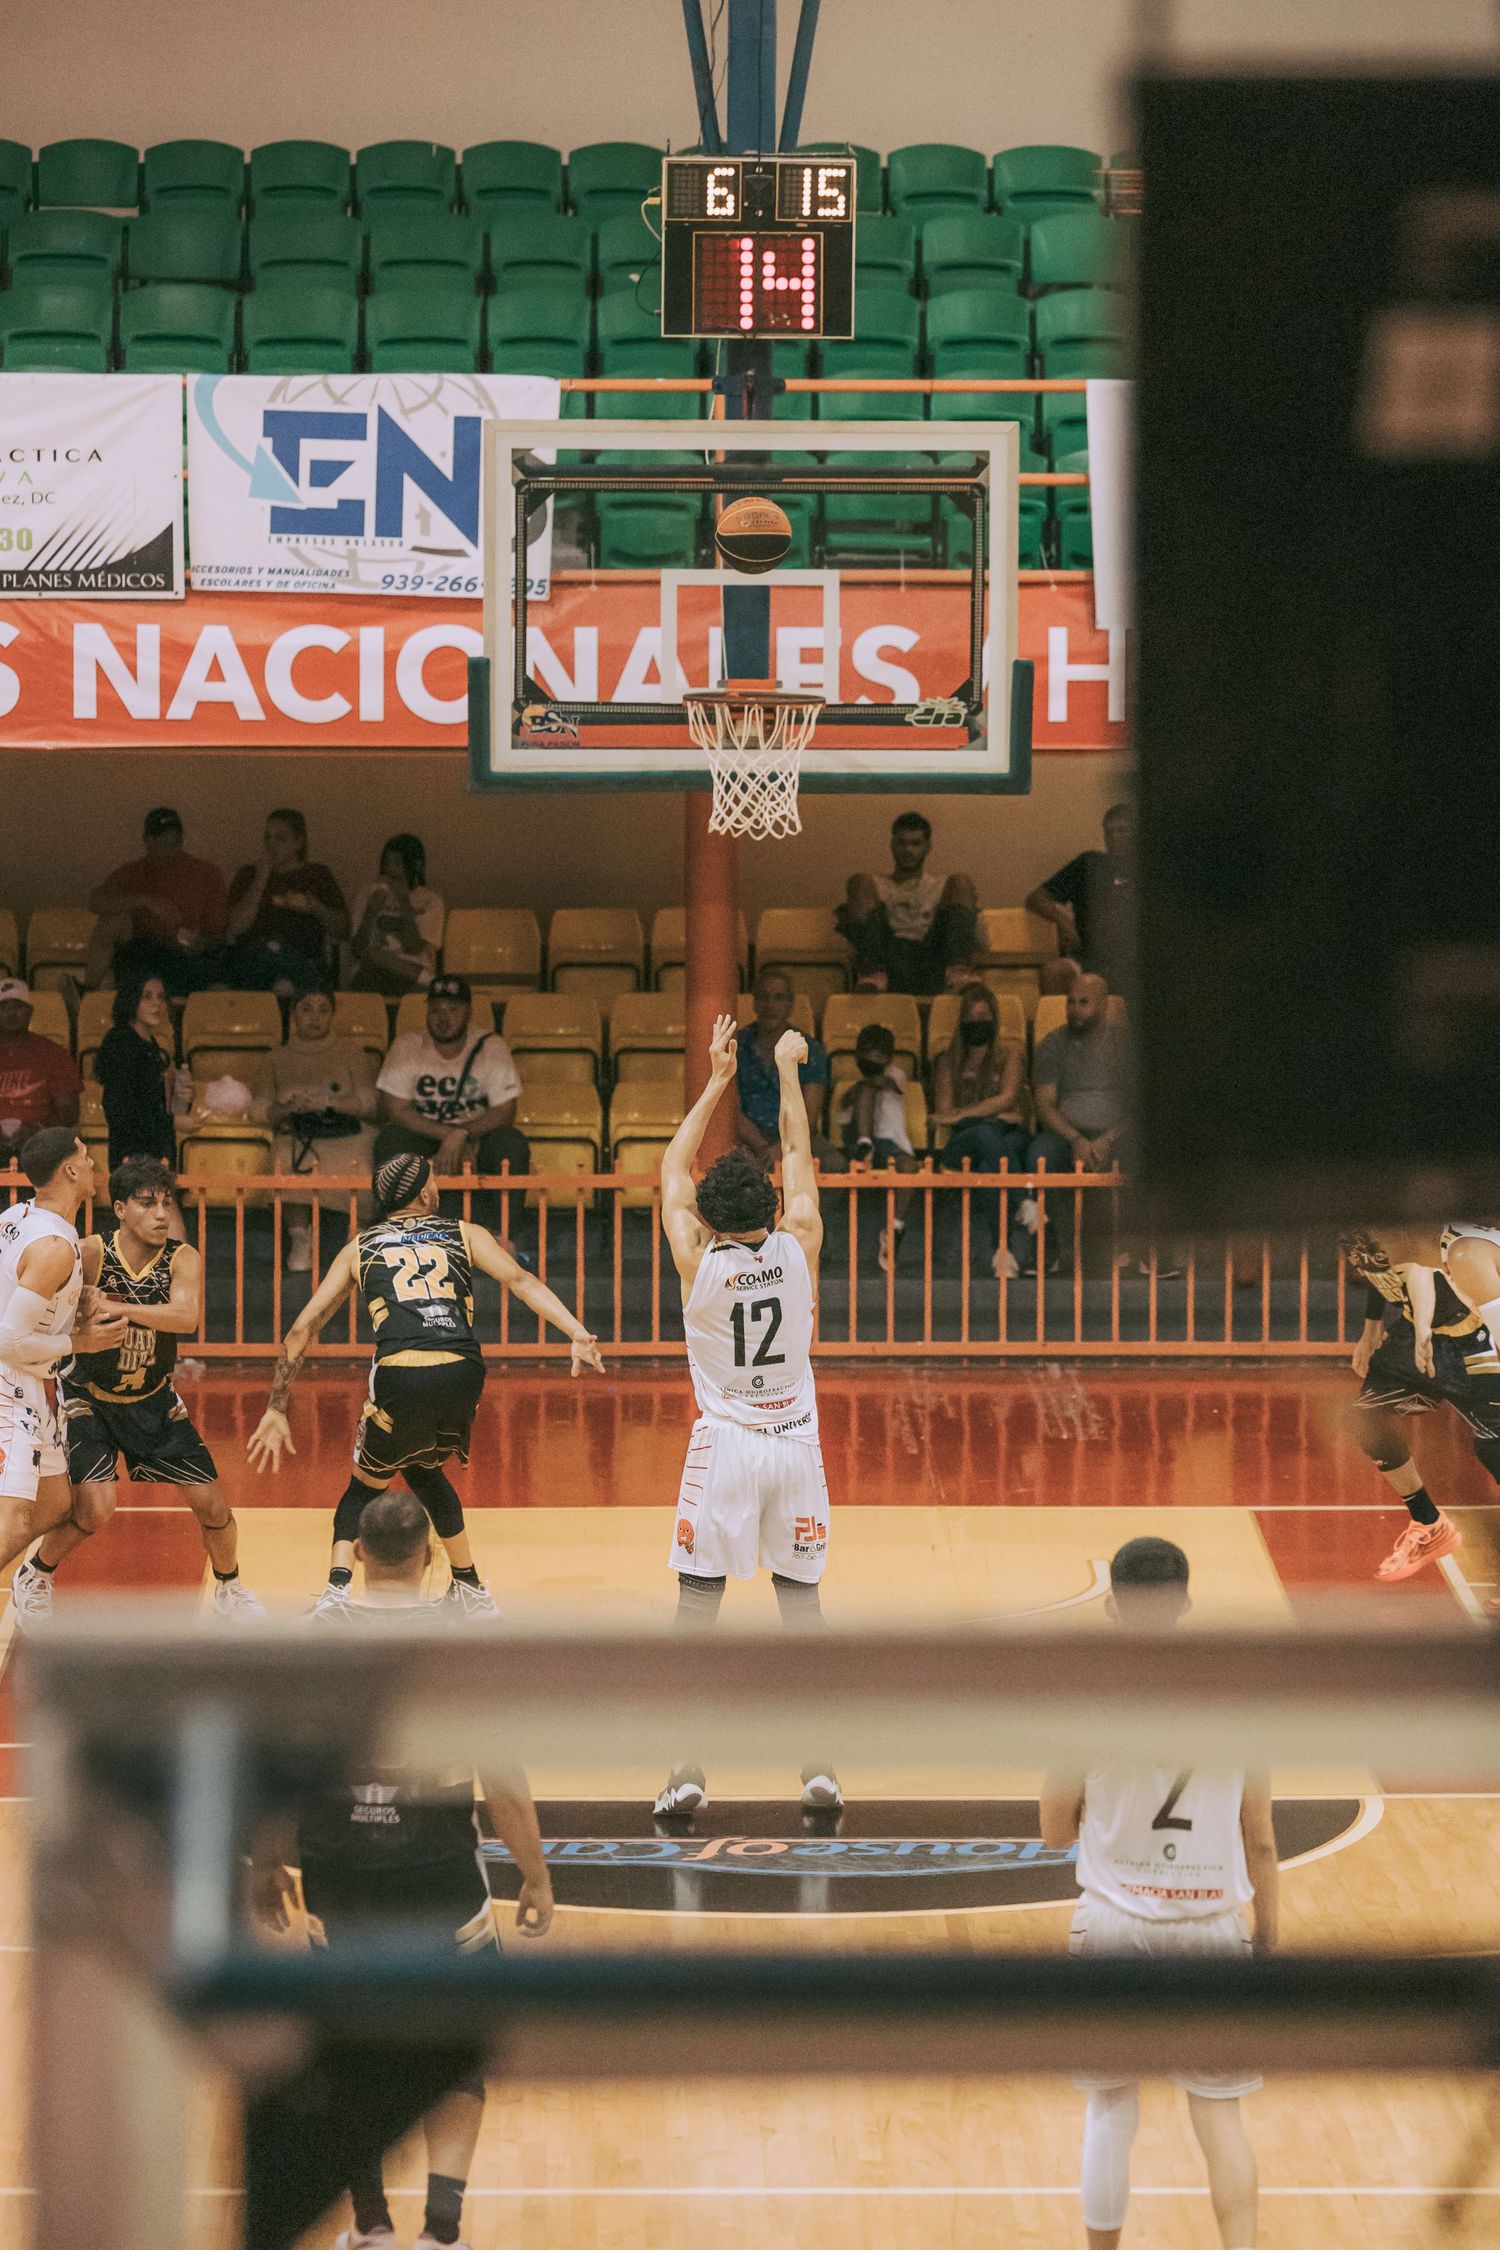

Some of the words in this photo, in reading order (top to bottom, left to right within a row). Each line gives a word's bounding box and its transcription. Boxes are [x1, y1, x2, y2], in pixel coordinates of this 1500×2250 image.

[706, 166, 736, 216] 6
[802, 167, 847, 217] 15
[739, 237, 816, 330] 14
[0, 449, 102, 462] CTICA
[263, 404, 482, 549] EN
[32, 491, 56, 504] DC
[3, 573, 72, 588] PLANES
[77, 570, 165, 588] MÉDICOS
[258, 567, 264, 575] Y
[268, 568, 350, 577] MANUALIDADES
[200, 578, 261, 587] ESCOLARES
[293, 581, 336, 589] OFICINA
[72, 622, 921, 724] NACIONAES
[382, 1247, 457, 1303] 22
[738, 1266, 783, 1285] COAMO
[729, 1297, 786, 1368] 12
[793, 1543, 810, 1552] Bar
[1150, 1767, 1194, 1832] 2
[350, 1814, 401, 1824] MULTIPLES
[353, 1806, 397, 1815] SEGUROS
